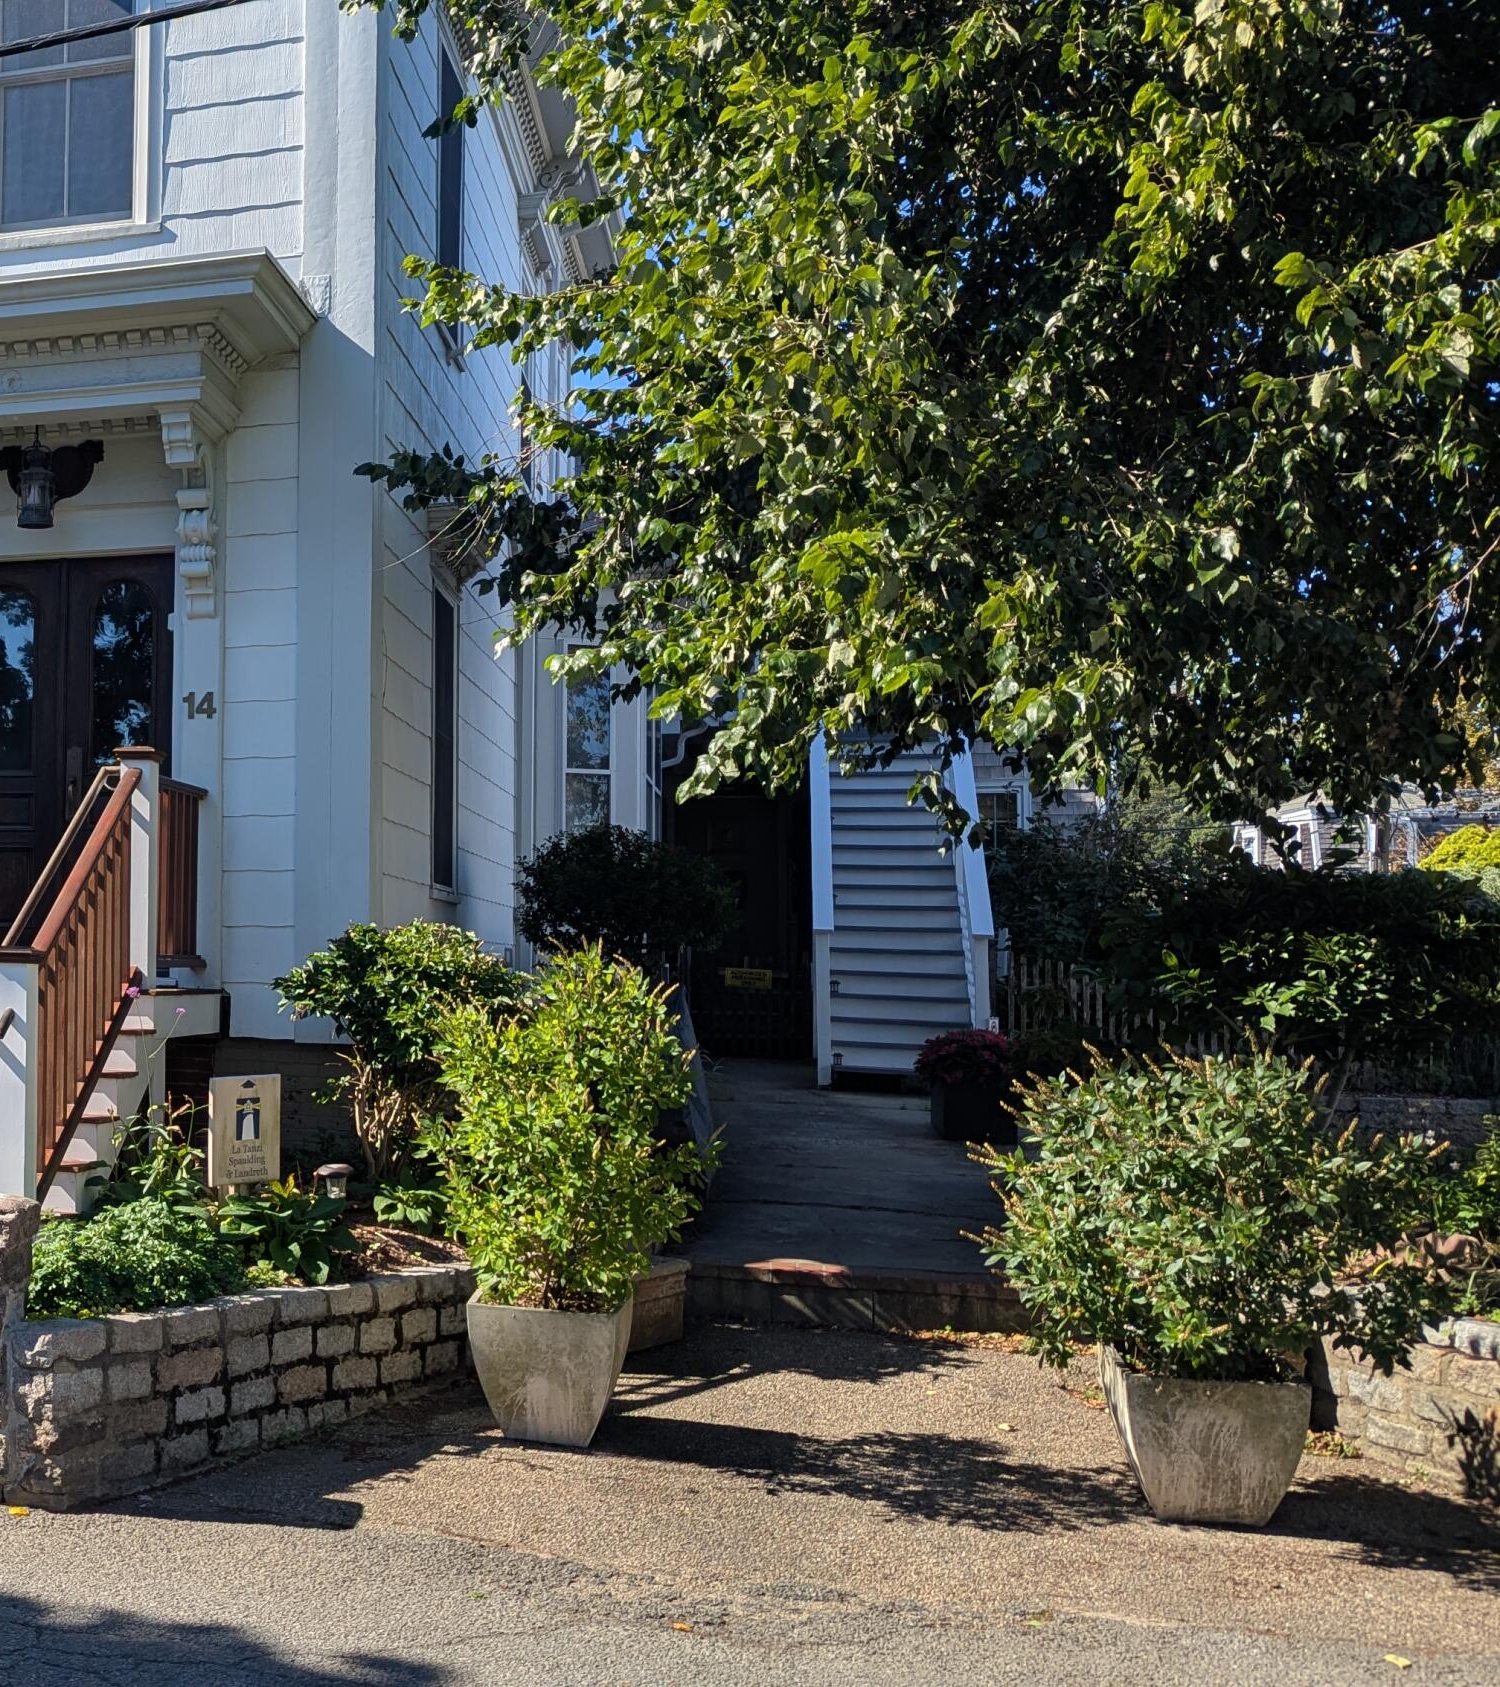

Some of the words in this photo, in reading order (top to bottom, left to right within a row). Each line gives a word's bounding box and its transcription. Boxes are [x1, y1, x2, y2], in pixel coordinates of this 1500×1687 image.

[182, 691, 217, 720] 14
[232, 1144, 241, 1154] La
[228, 1154, 266, 1168] Spaulding
[226, 1169, 233, 1179] &
[234, 1166, 268, 1178] Landreth
